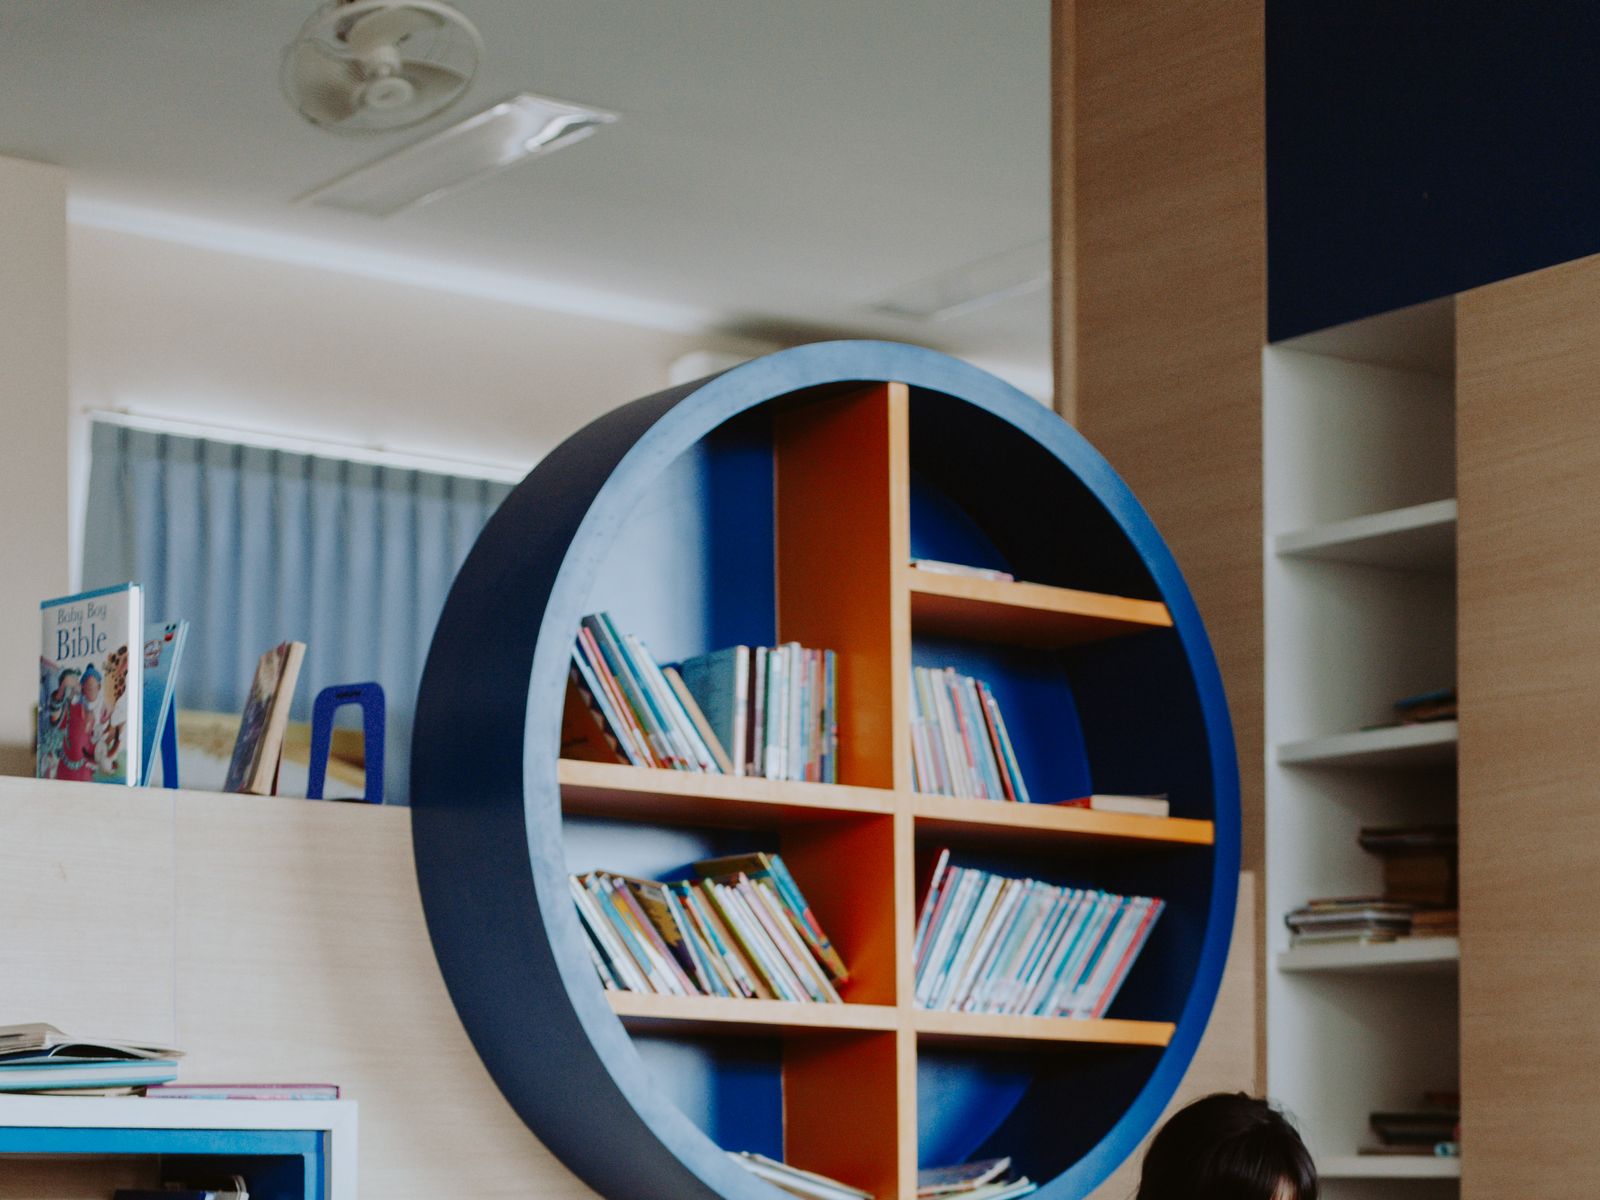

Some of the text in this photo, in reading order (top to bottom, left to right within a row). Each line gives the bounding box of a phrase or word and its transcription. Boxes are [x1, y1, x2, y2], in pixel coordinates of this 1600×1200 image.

[57, 602, 107, 625] Baby Boy
[56, 624, 108, 660] Bible
